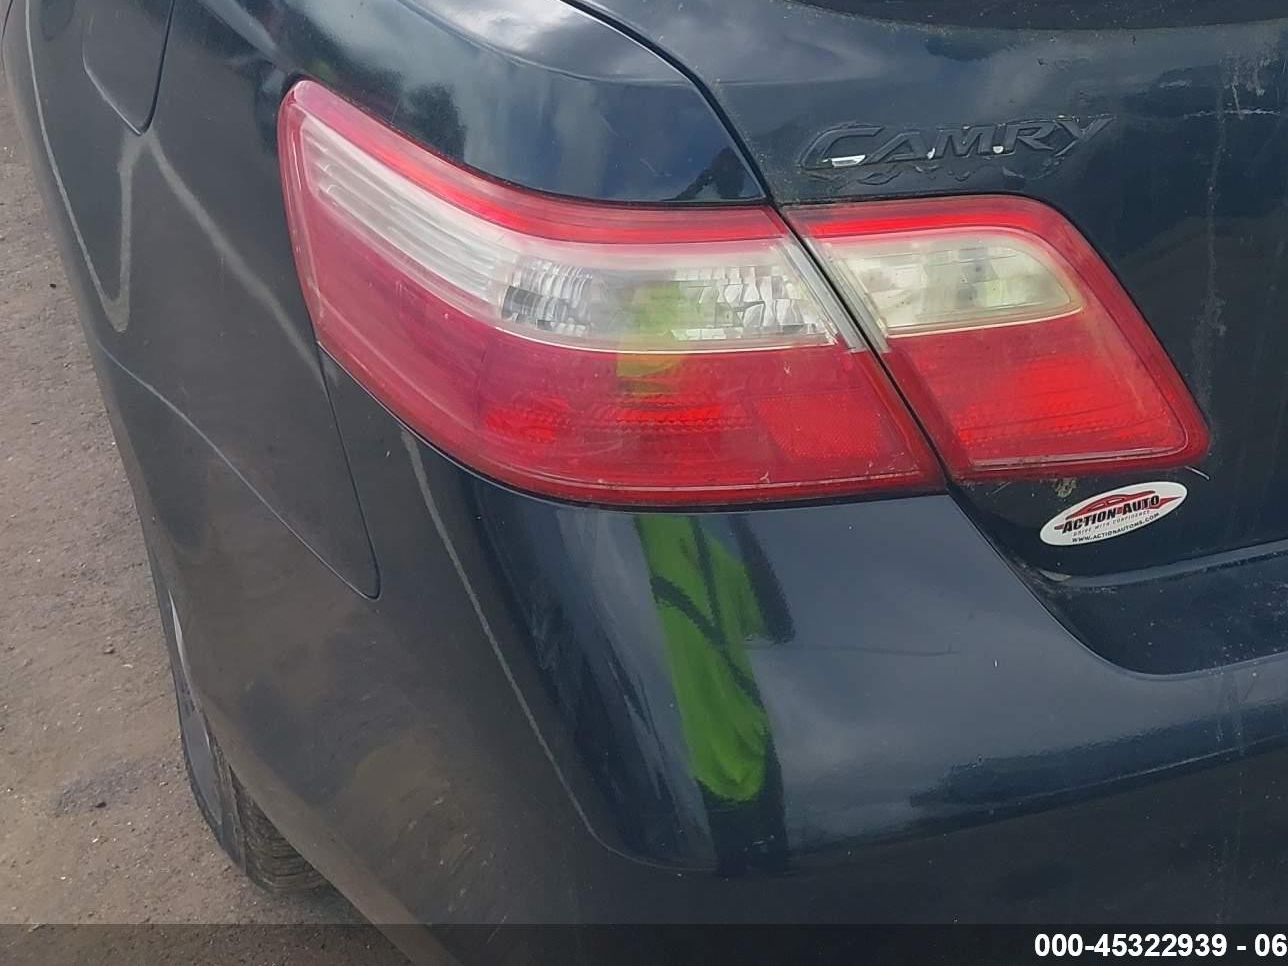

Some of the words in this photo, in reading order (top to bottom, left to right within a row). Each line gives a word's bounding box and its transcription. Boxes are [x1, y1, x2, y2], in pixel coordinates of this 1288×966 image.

[799, 113, 1115, 171] CAMRY
[1062, 508, 1117, 534] ACTION
[1121, 495, 1160, 516] AUTO
